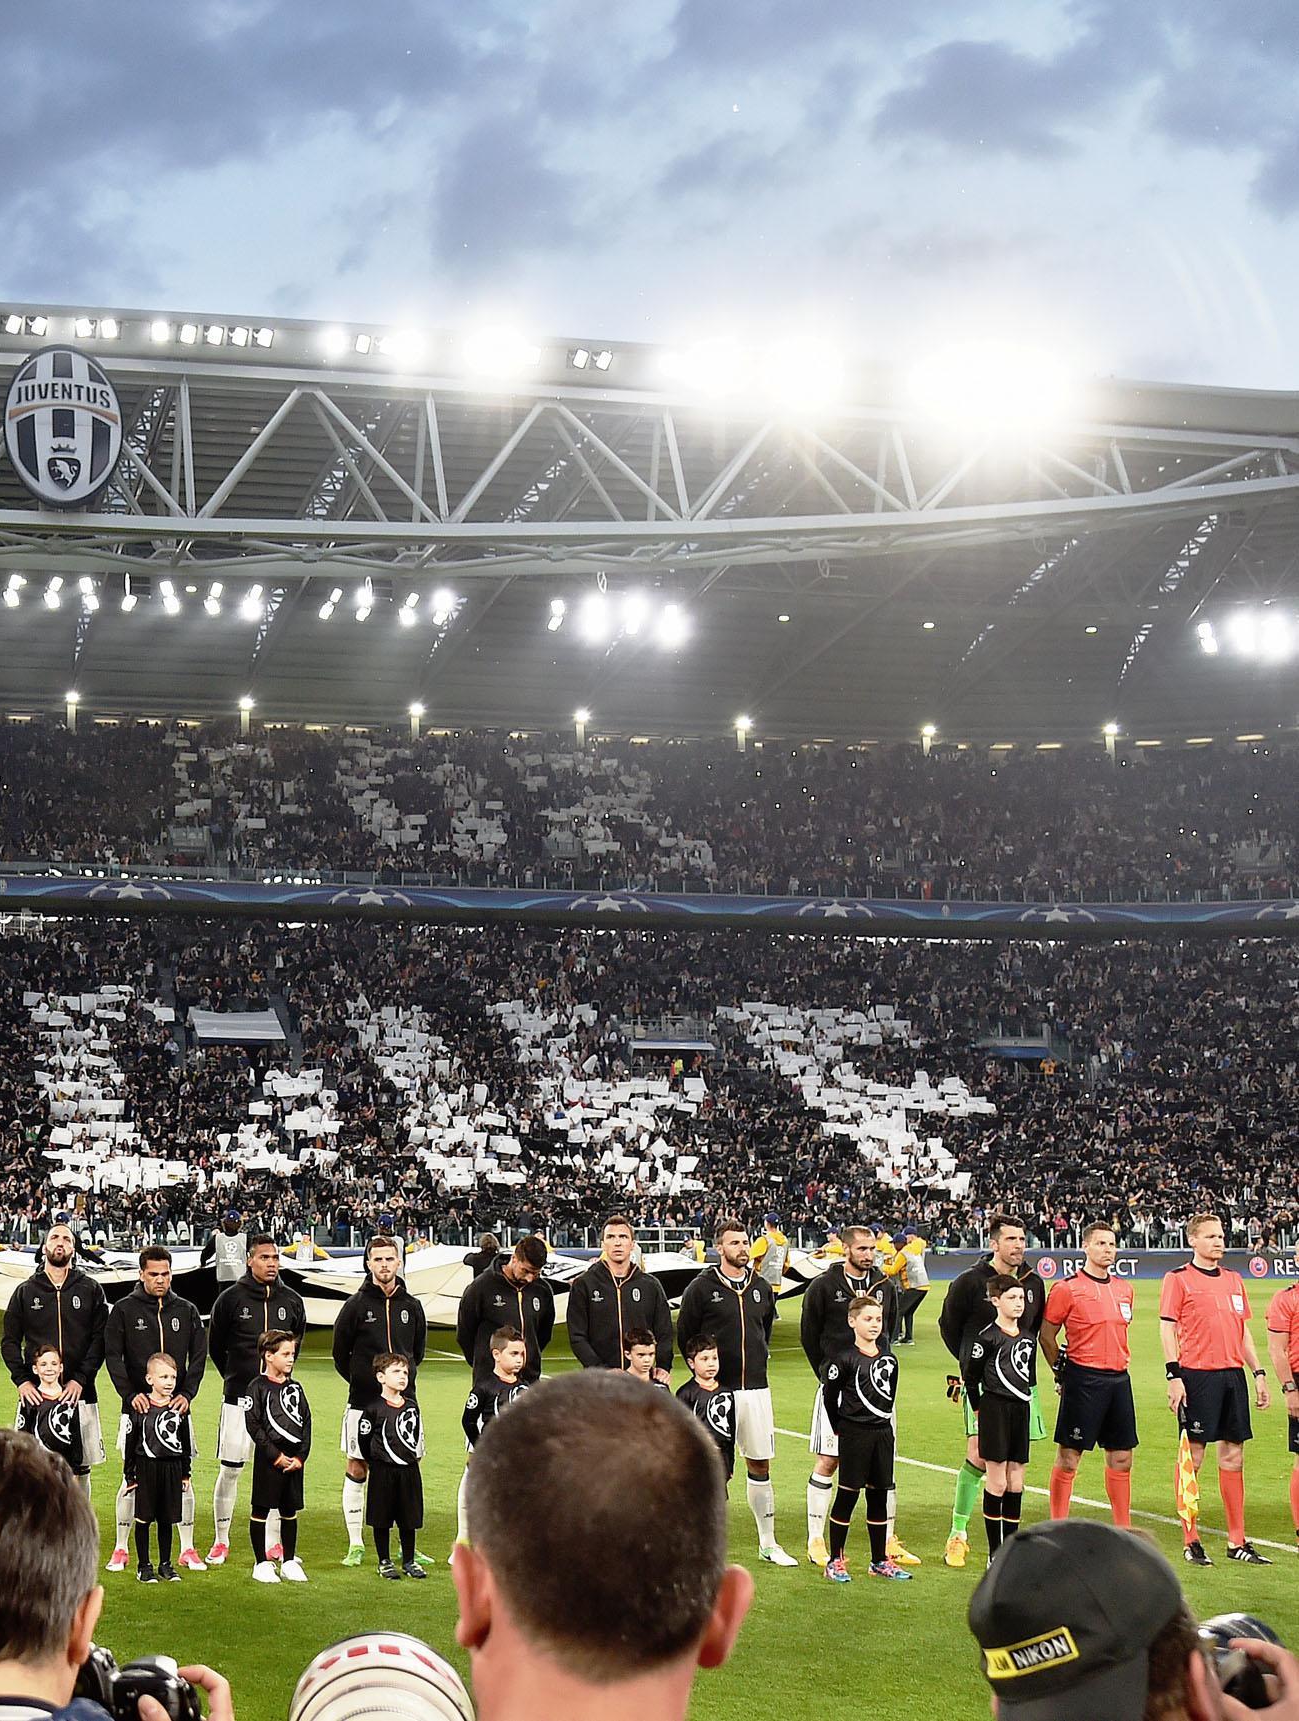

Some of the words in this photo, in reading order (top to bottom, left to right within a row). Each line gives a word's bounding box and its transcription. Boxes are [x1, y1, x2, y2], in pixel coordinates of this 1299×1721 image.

[16, 383, 110, 407] JUVENTUS
[1063, 1258, 1139, 1276] RECT
[1012, 1636, 1070, 1668] NIKON
